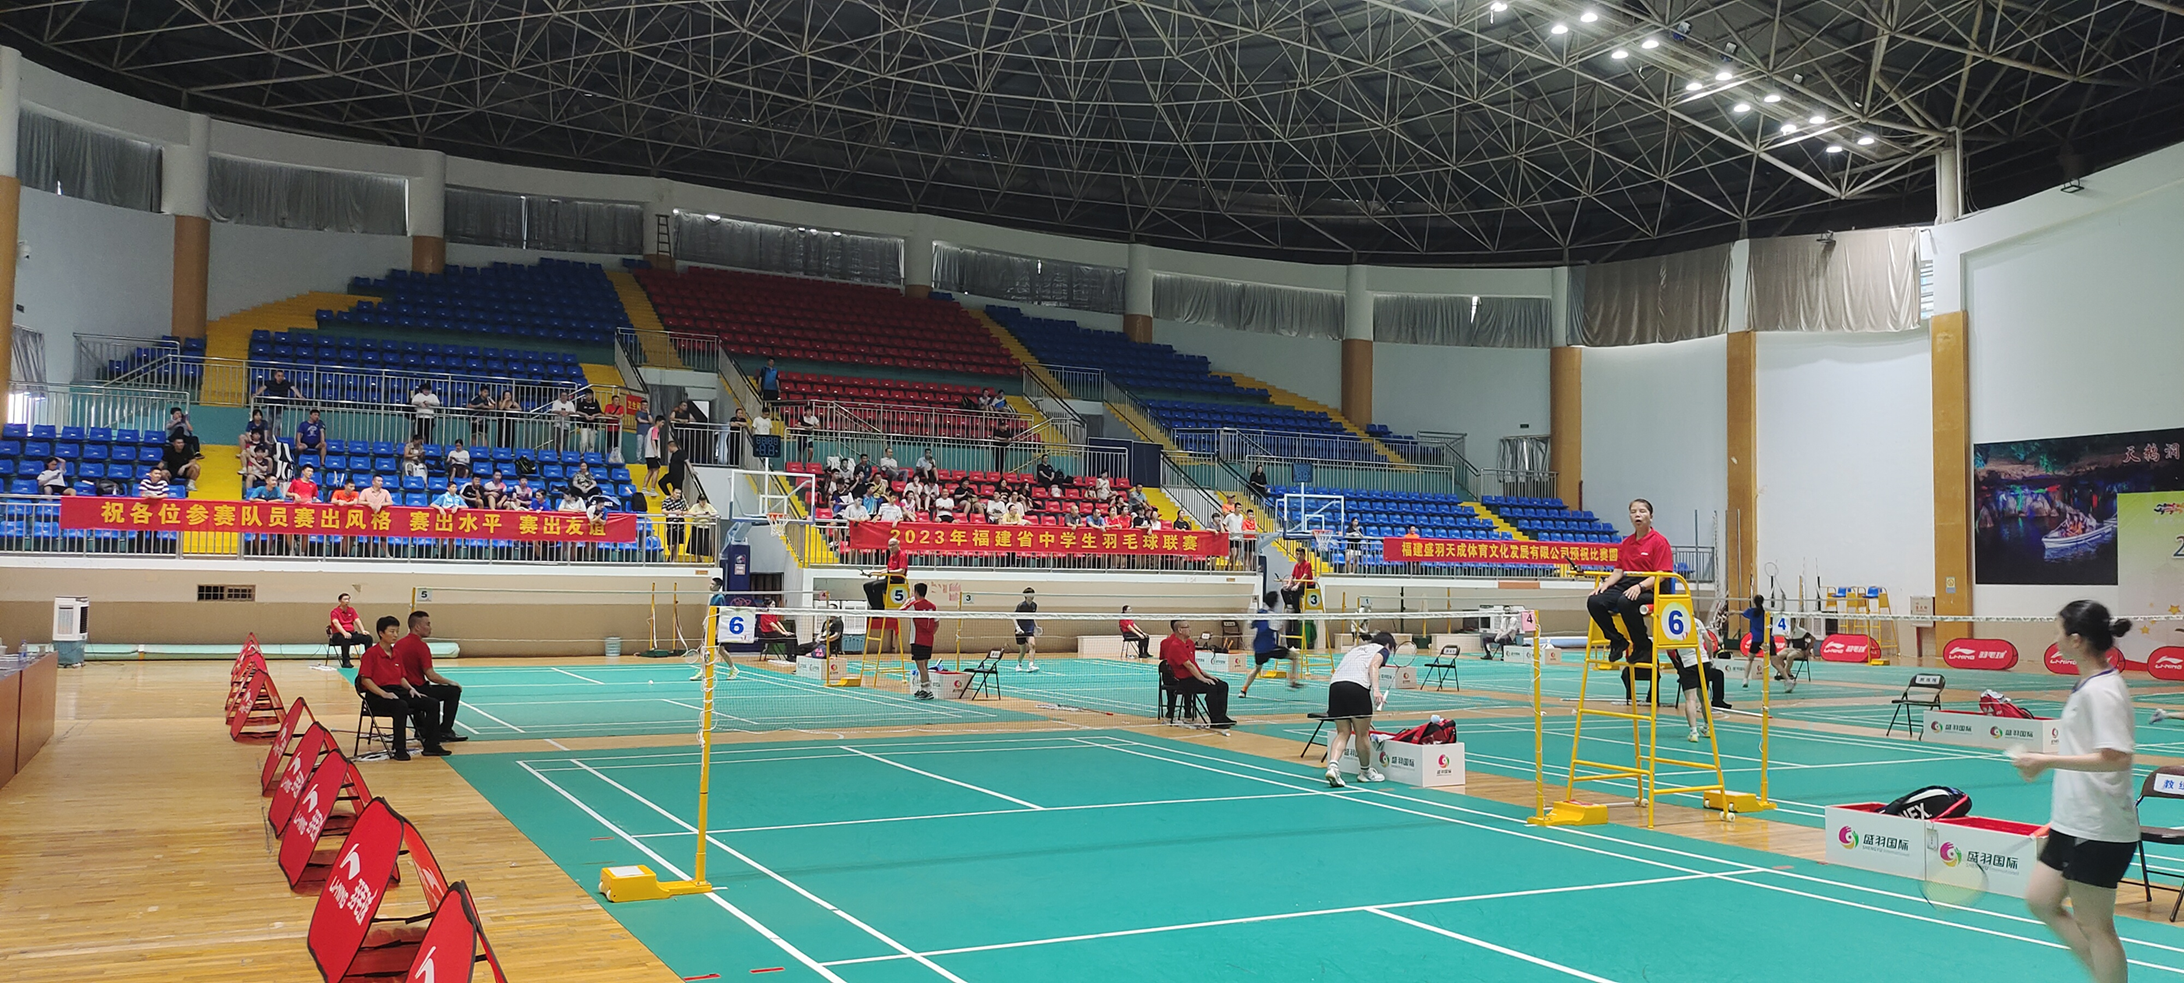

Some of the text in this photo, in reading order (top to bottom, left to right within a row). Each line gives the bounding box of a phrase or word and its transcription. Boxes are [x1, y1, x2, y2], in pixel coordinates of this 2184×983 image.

[101, 501, 392, 531] 祝各位参赛队员赛出风格
[410, 511, 502, 534] 赛出水平
[890, 528, 1198, 552] 2023年福建省中学生羽毛球联赛
[420, 590, 428, 599] 5
[895, 589, 904, 602] 5
[965, 594, 972, 602] 3
[1310, 594, 1318, 605] 3
[729, 616, 745, 635] 6
[1526, 614, 1533, 624] 4
[1668, 610, 1684, 635] 6
[1777, 617, 1787, 631] 4
[1862, 834, 1910, 851] 盛羽国际
[1967, 851, 2019, 870] 盛羽国际
